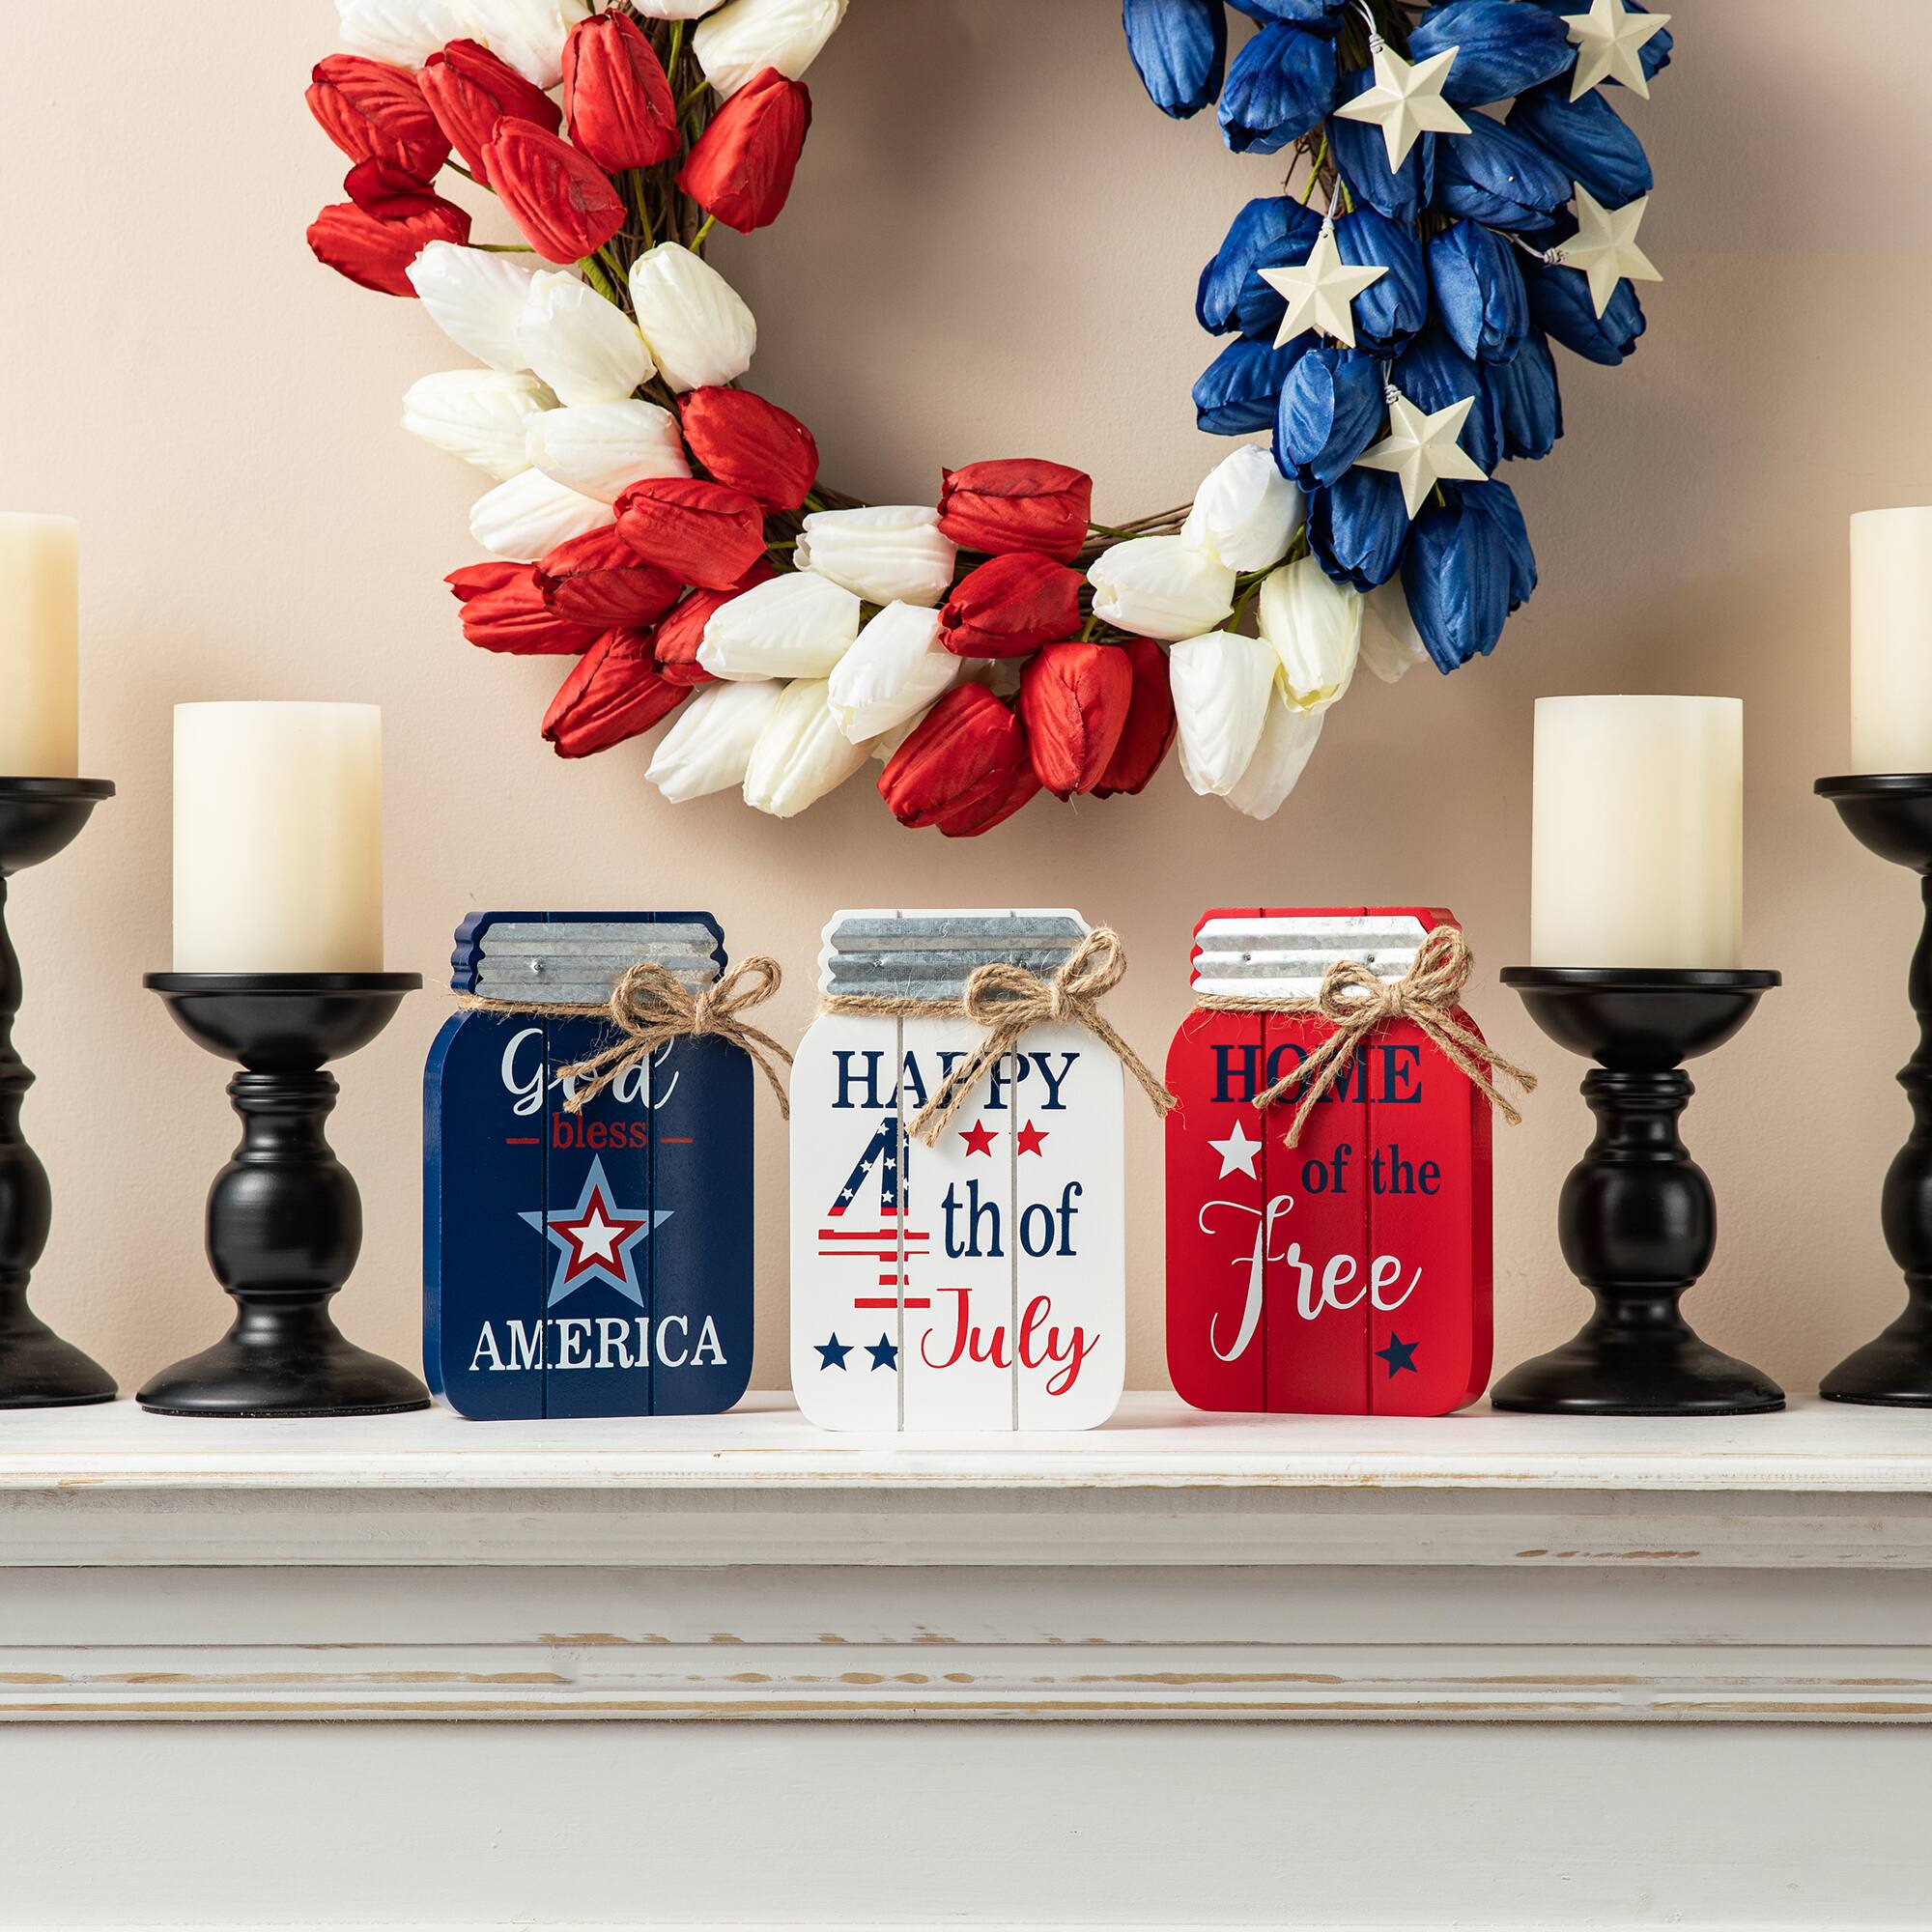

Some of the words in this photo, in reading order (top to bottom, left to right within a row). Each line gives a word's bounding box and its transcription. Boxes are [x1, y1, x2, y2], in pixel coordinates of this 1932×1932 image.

[832, 1050, 1080, 1110] HAPPY
[1210, 1043, 1422, 1103] HOME
[553, 1112, 647, 1149] bless
[1301, 1144, 1351, 1195] of
[1371, 1144, 1440, 1195] the
[1019, 1180, 1083, 1258] of
[1199, 1194, 1422, 1361] Free
[469, 1315, 726, 1371] AMERICA
[921, 1288, 1100, 1396] July
